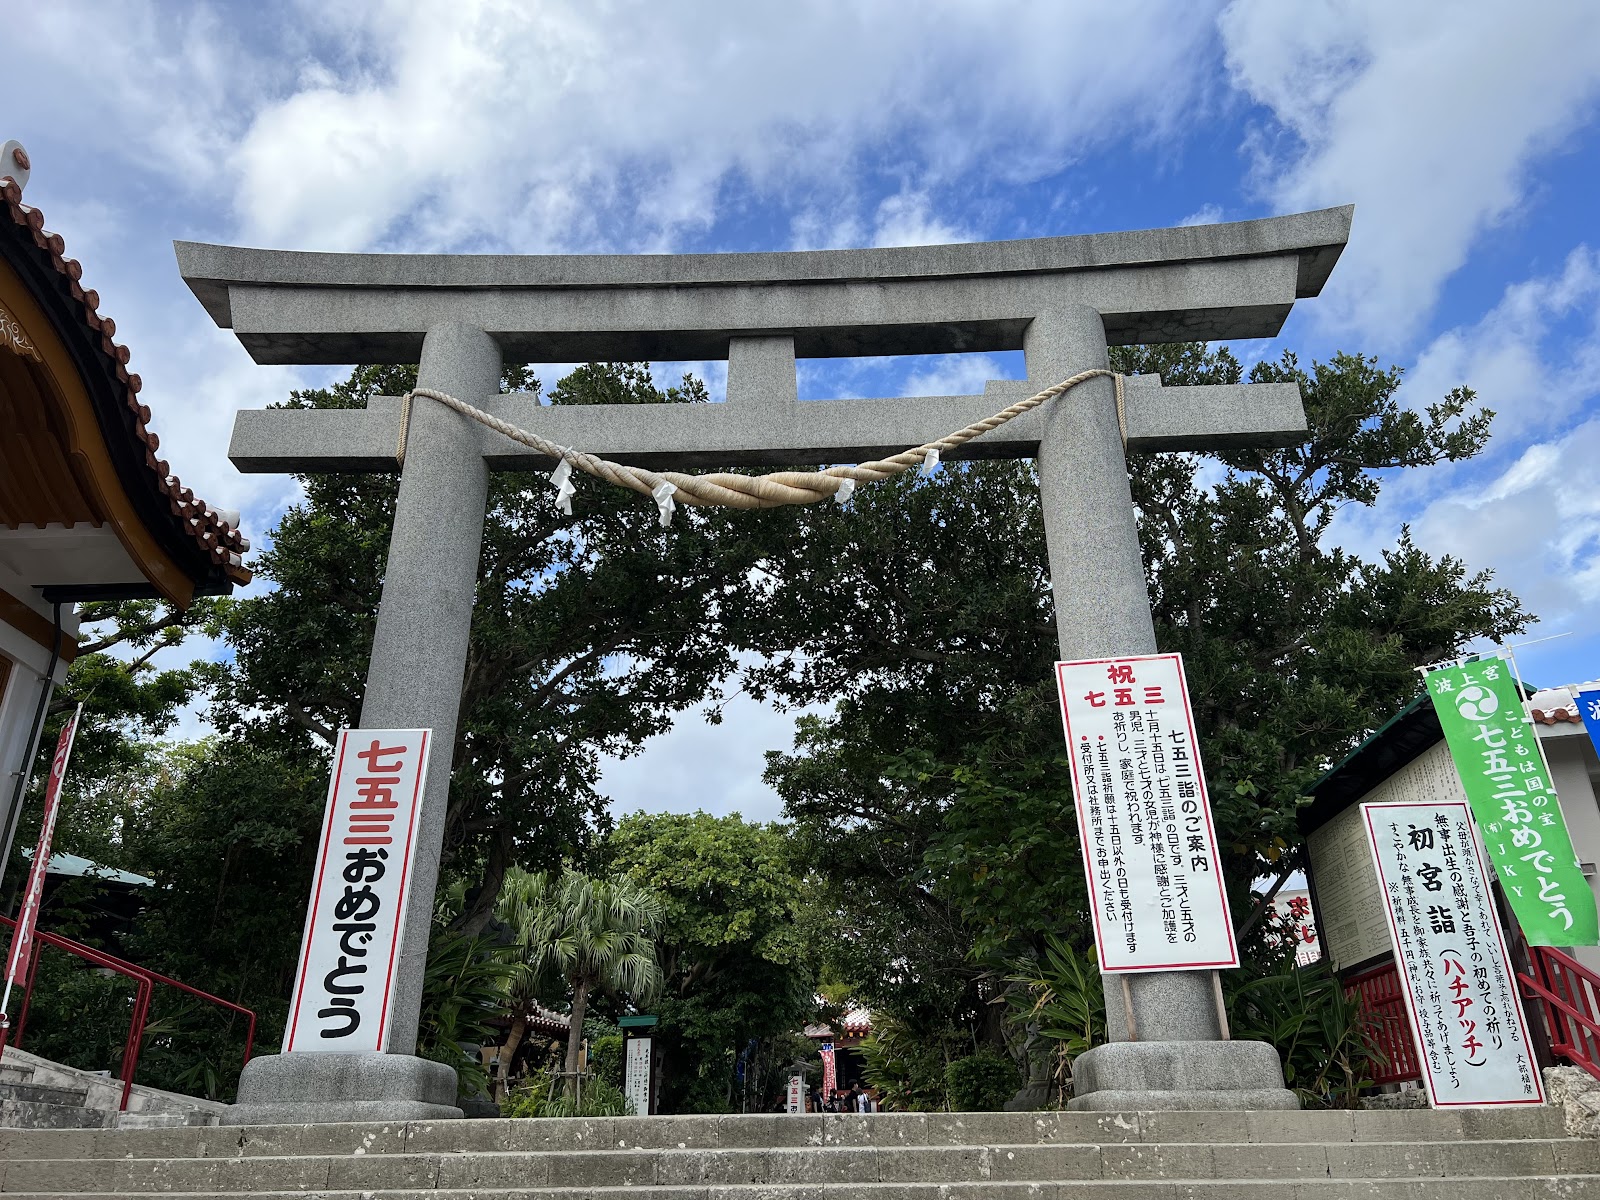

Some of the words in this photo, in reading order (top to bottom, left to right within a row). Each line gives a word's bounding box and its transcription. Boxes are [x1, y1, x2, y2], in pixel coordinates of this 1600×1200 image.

[1084, 686, 1165, 708] 七五三
[1107, 665, 1136, 685] 祝
[1434, 665, 1500, 694] 波上宮
[1168, 729, 1209, 872] 七五三詣のご案内
[1504, 711, 1557, 827] こどもは国の宝
[1472, 724, 1574, 931] 七五三おめでとう
[317, 739, 408, 1039] 七五三おめでとう
